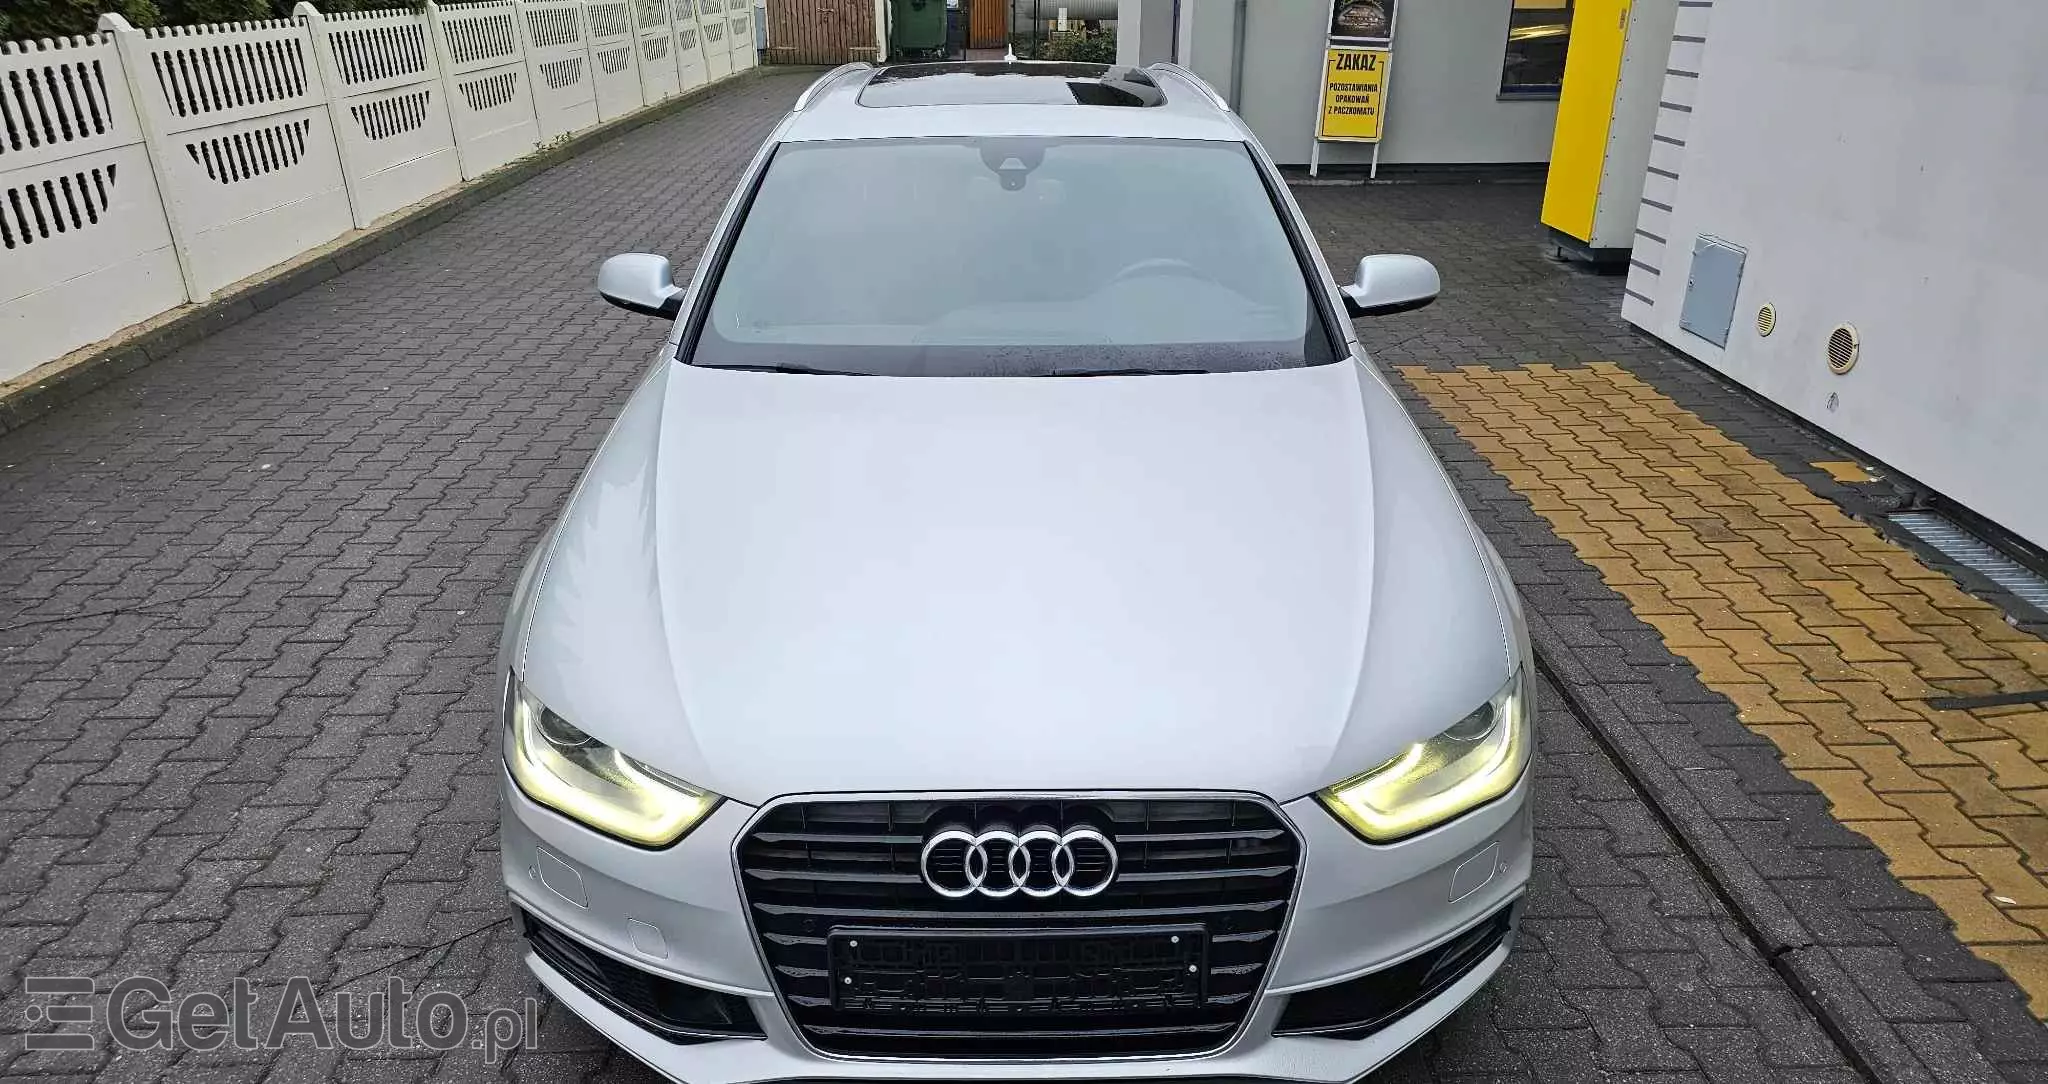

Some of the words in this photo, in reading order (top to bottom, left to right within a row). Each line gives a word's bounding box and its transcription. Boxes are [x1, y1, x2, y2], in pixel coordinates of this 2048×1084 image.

[1336, 53, 1376, 71] ZAKAZ
[1329, 83, 1377, 92] POZOSTAWIANIA
[1335, 94, 1369, 103] OPAKOWAŃ
[1328, 106, 1332, 114] Z
[1334, 106, 1374, 115] PACZKOMATU
